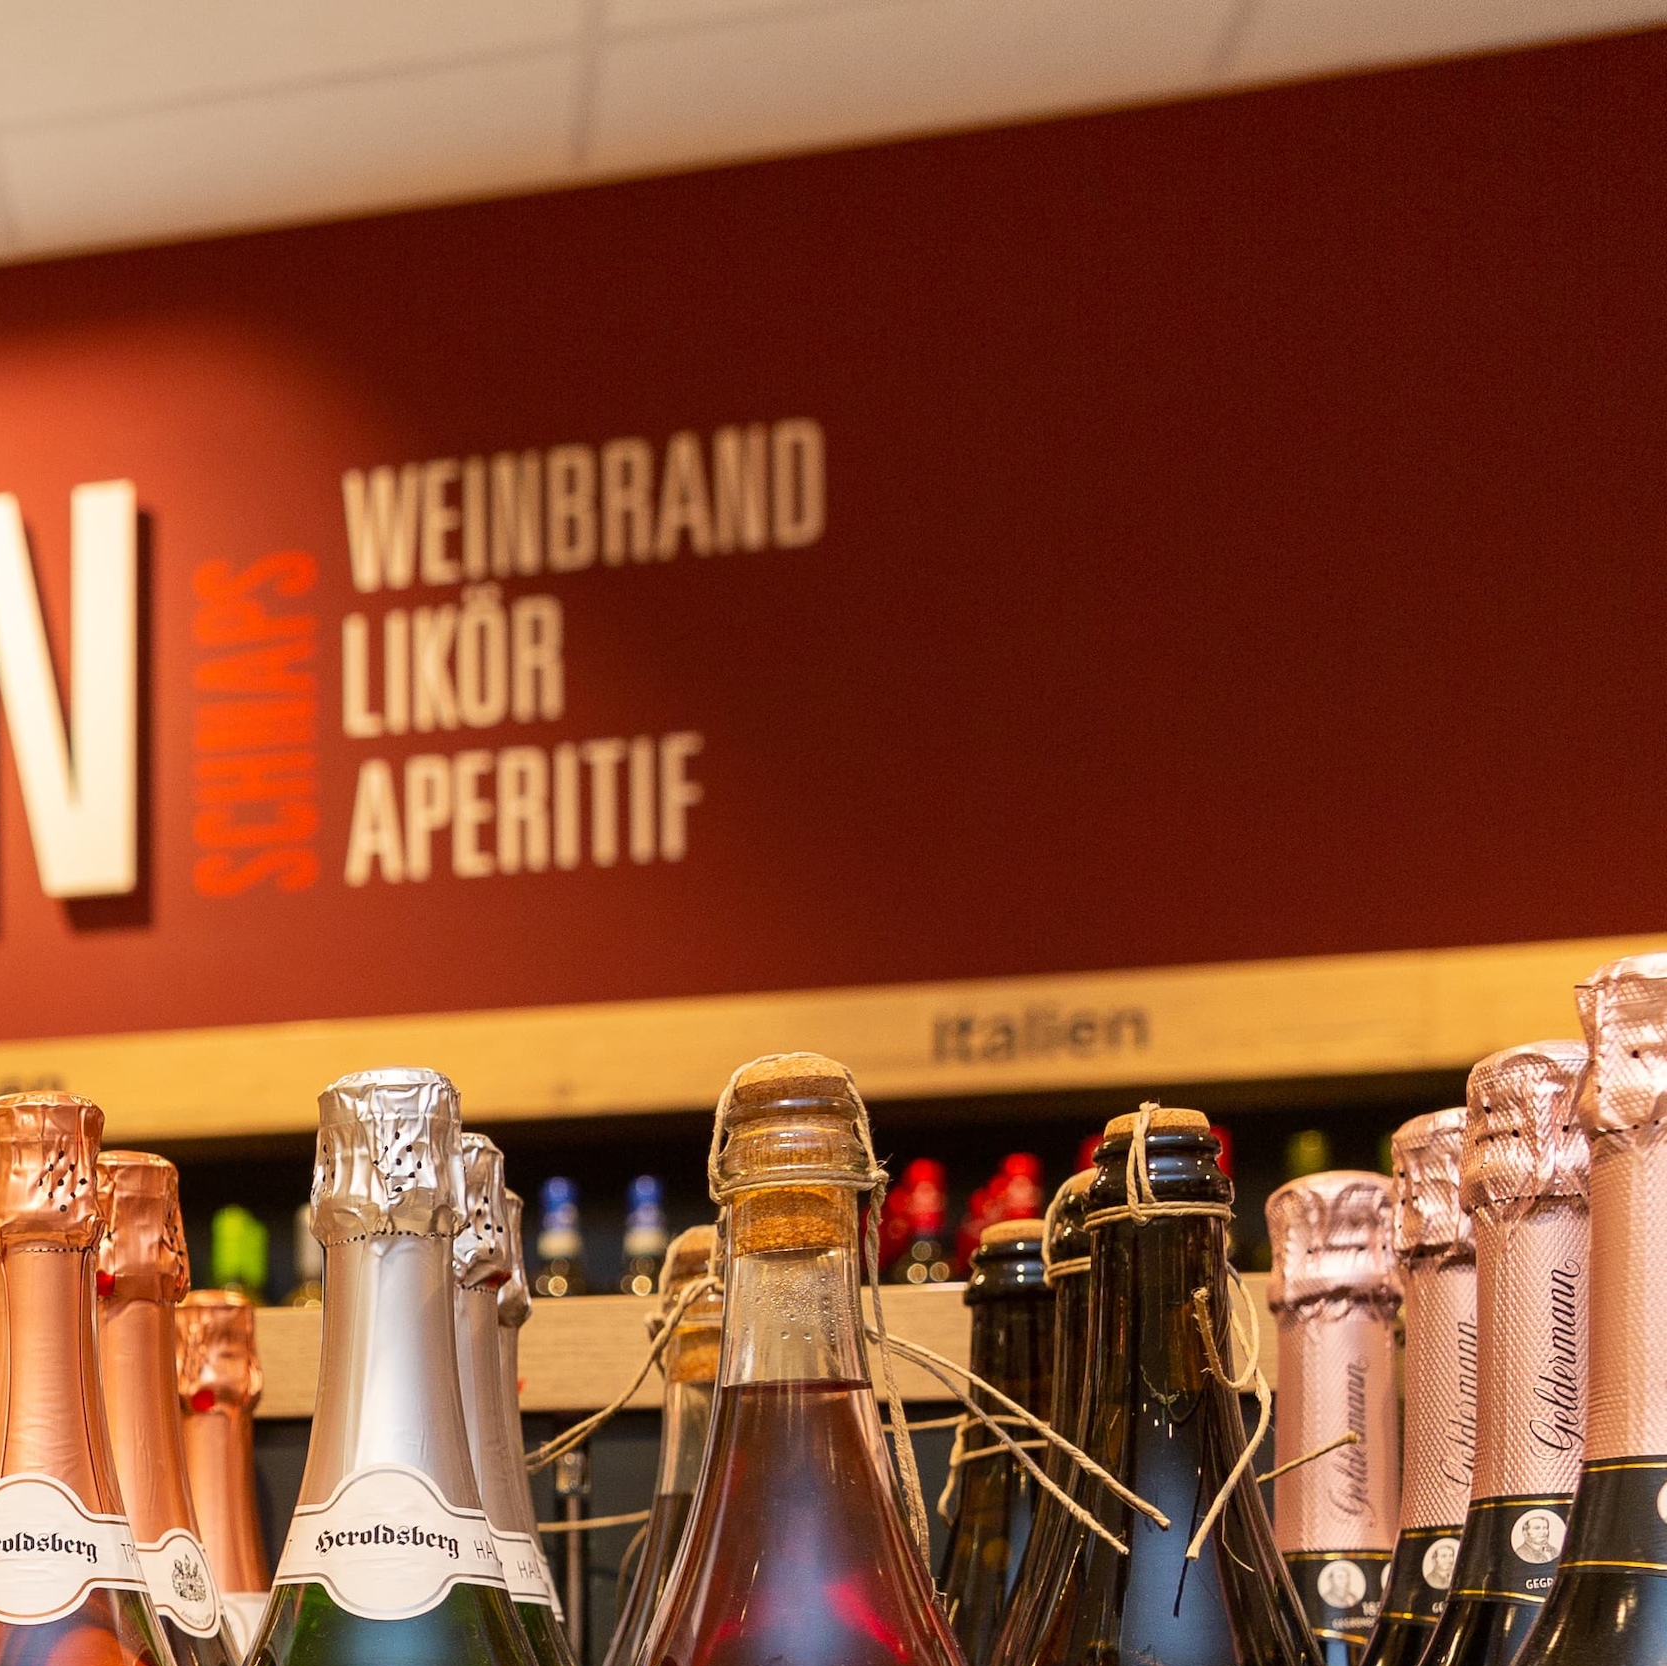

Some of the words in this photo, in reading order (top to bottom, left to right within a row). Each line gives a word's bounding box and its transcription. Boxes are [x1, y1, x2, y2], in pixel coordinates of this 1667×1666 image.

[341, 418, 828, 592] WEINBRAND
[341, 583, 564, 738] LIKÖR
[344, 731, 705, 887] APERITIF
[929, 1000, 1153, 1063] Italien
[1527, 1257, 1580, 1457] Geldermann
[315, 1524, 459, 1559] Heroldsberg
